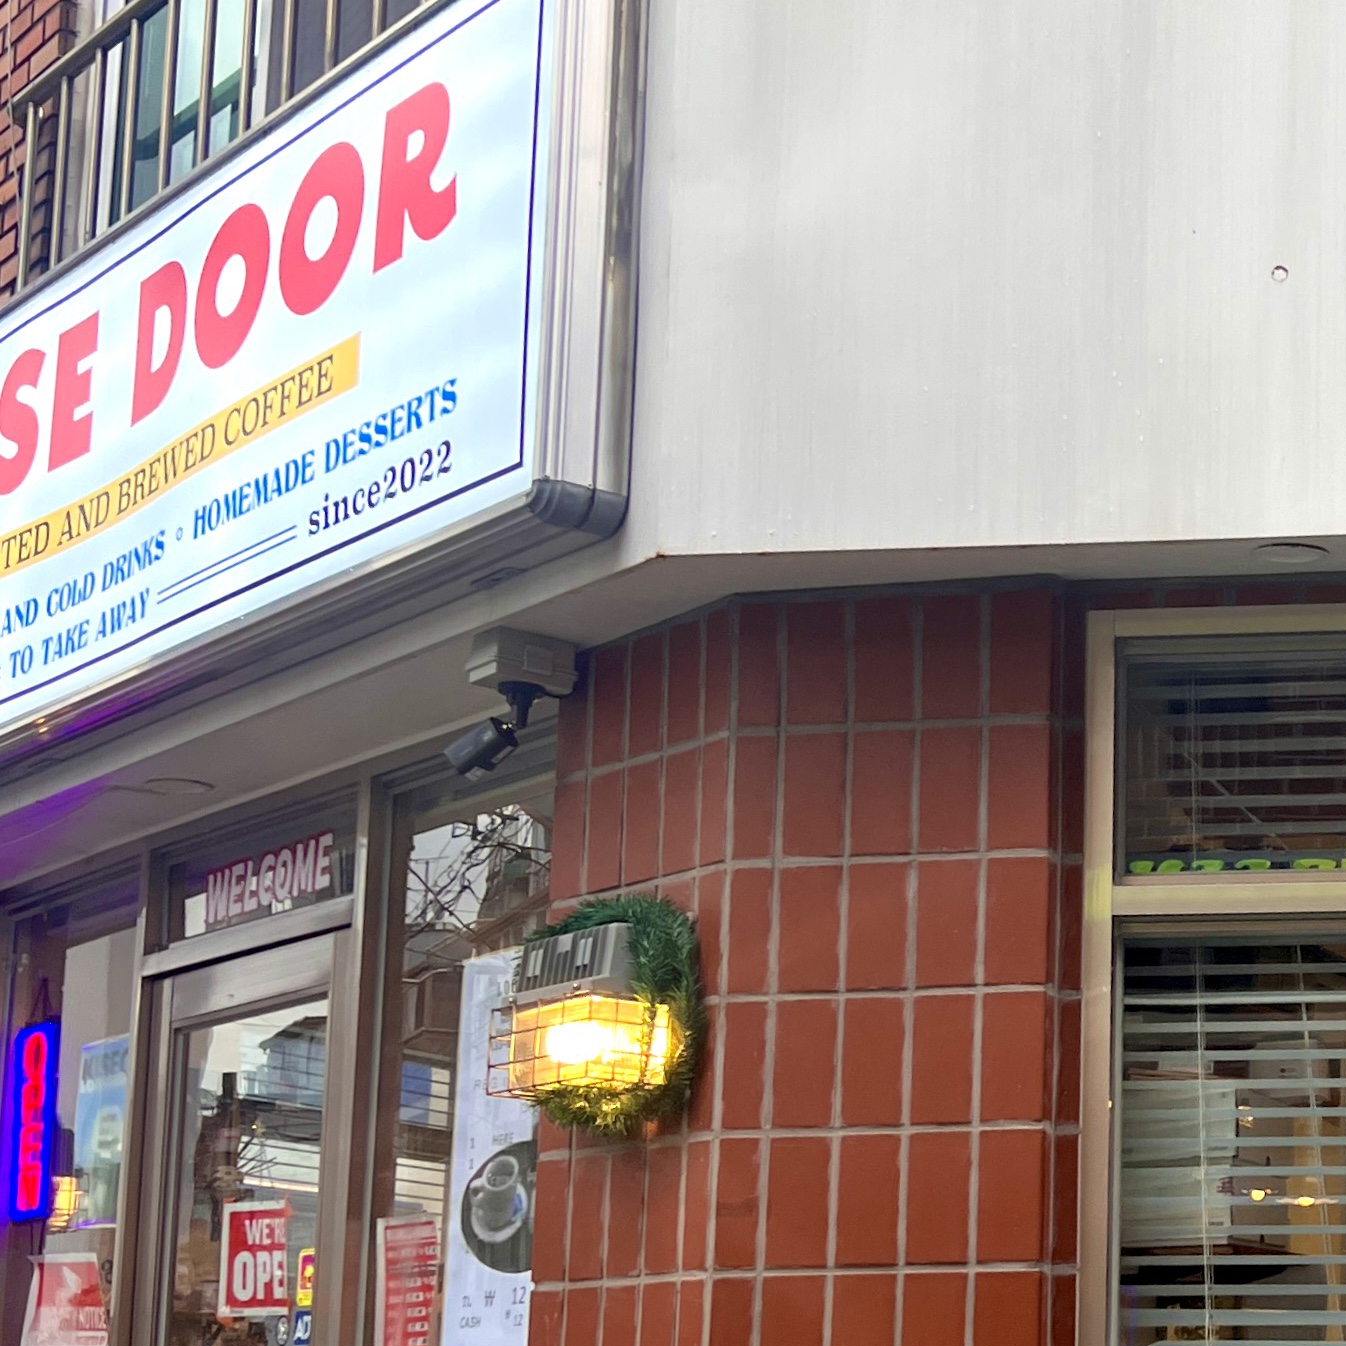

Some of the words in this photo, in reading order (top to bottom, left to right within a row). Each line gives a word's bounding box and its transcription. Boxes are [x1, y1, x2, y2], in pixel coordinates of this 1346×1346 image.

[130, 82, 457, 427] DOOR
[0, 597, 39, 638] AND
[46, 571, 96, 618] COLD
[101, 529, 166, 593] DRINKS
[192, 449, 316, 540] HOMEMADE
[324, 377, 458, 474] DESSERTS
[2, 520, 50, 570] TED
[57, 490, 110, 547] AND
[116, 422, 216, 516] BREWED
[223, 354, 334, 447] COFFEE
[308, 440, 453, 536] since2022
[9, 645, 34, 679] TO
[42, 619, 90, 666] TAKE
[94, 587, 150, 642] AWAY
[206, 831, 334, 924] WELCOME
[16, 1031, 48, 1212] OPEN
